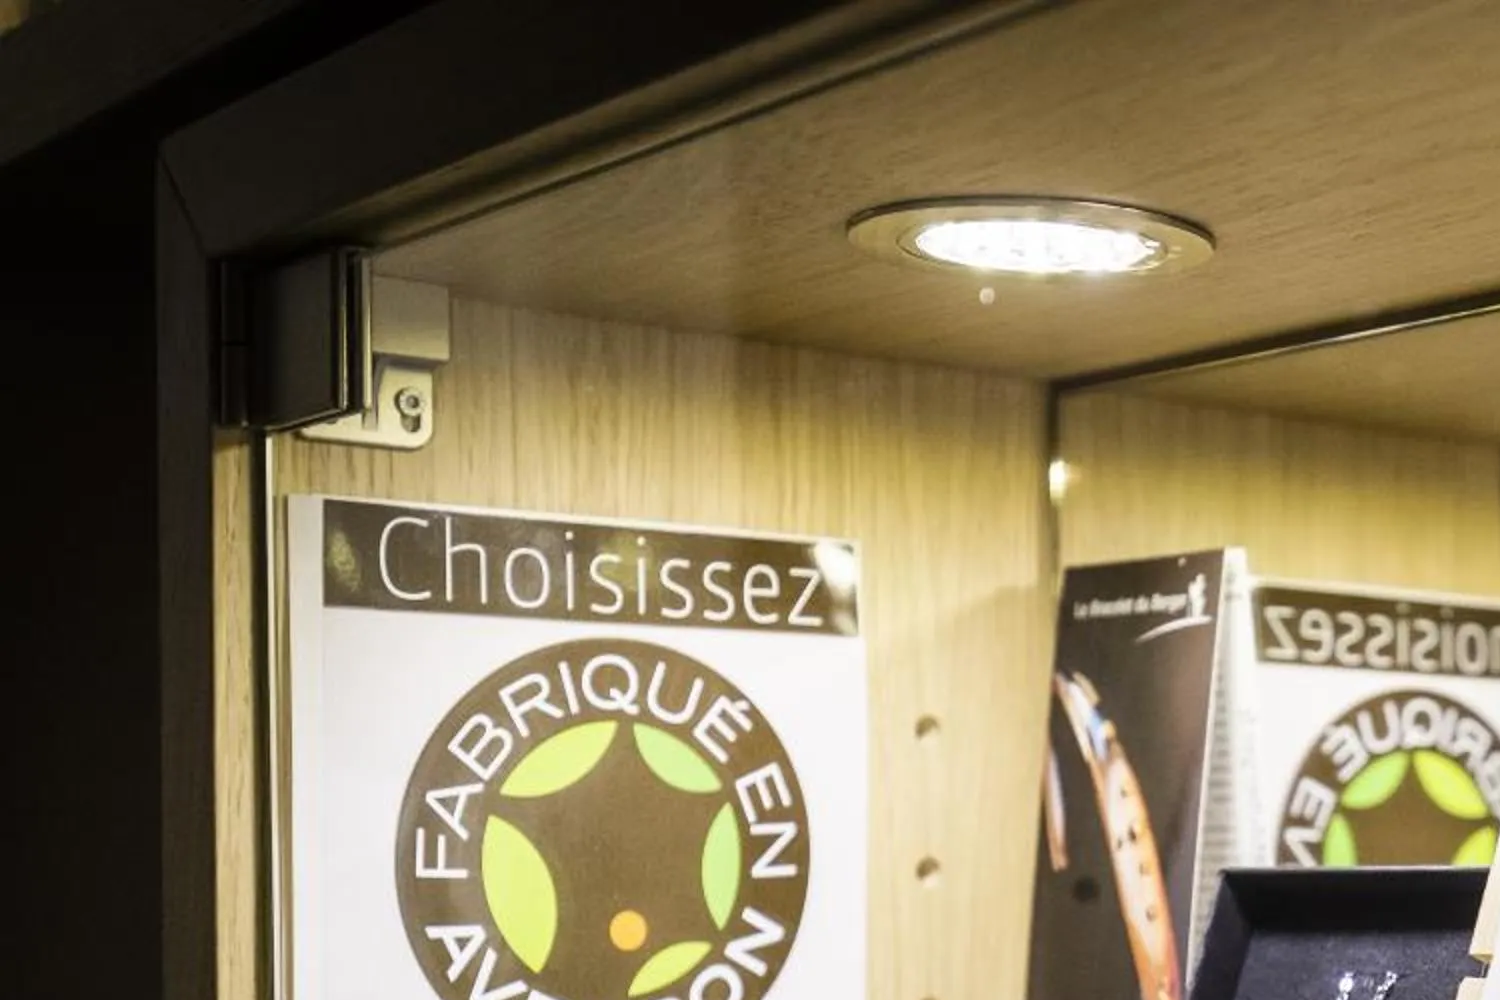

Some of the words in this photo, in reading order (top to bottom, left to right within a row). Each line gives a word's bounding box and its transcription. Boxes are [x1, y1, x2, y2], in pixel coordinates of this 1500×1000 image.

[379, 516, 824, 627] Choisissez
[415, 653, 752, 880] FABRIQUÉ
[735, 761, 799, 881] EN
